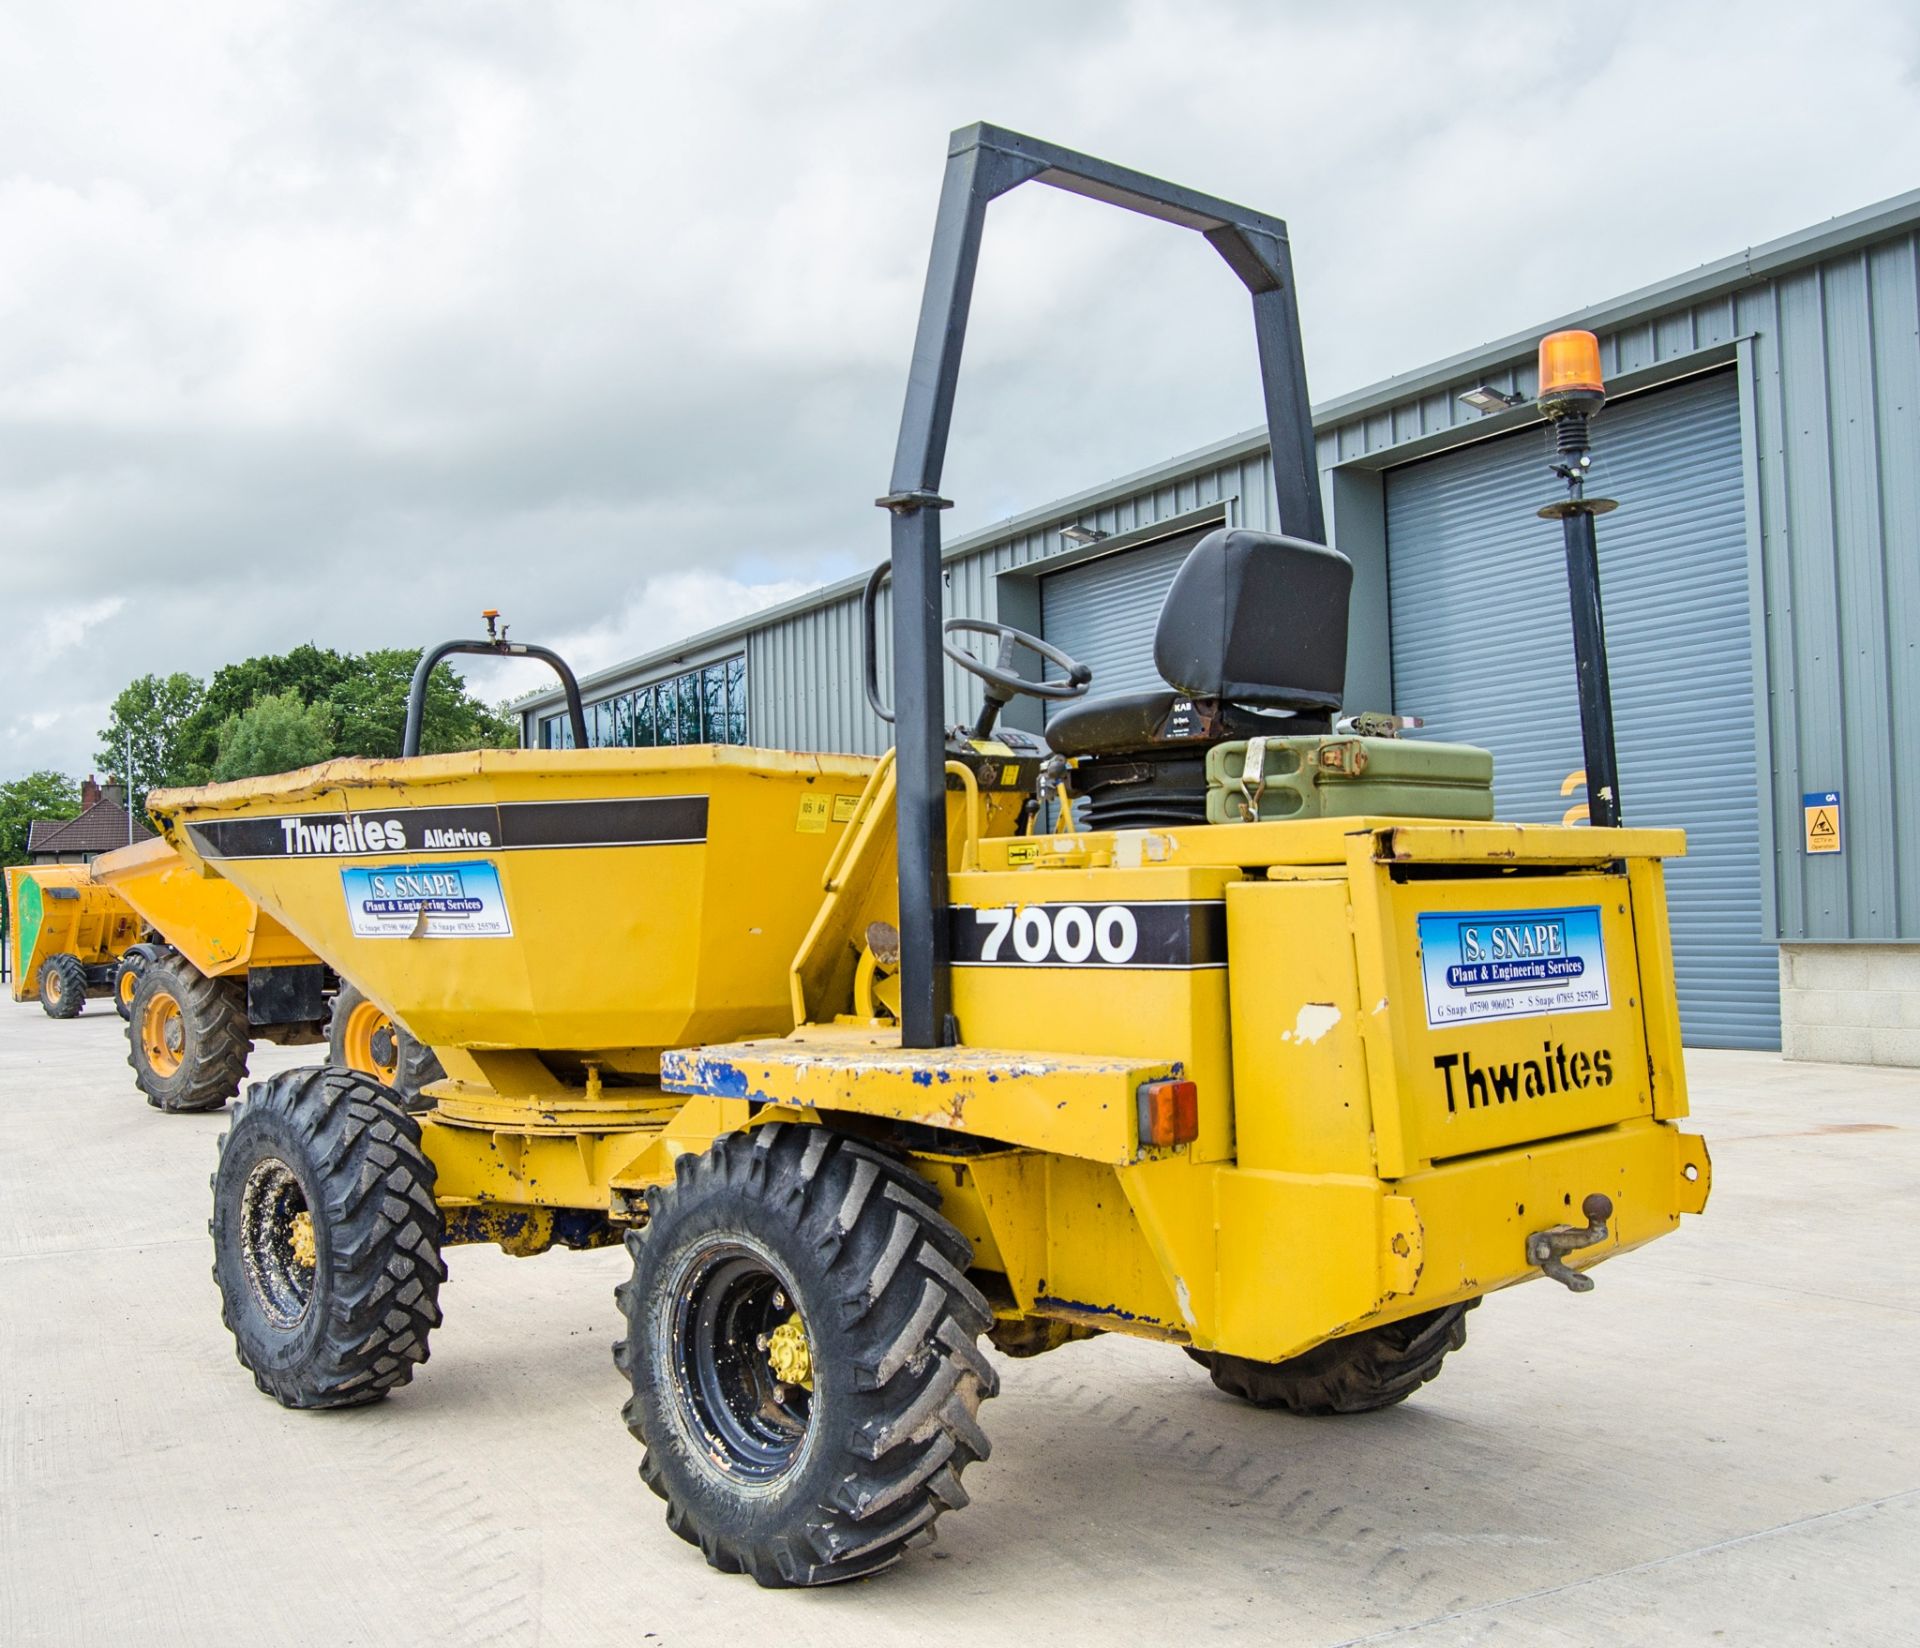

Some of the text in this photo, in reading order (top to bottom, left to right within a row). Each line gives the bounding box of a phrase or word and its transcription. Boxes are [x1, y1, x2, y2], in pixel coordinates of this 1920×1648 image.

[281, 815, 492, 853] Thwaites Alldrive
[374, 873, 459, 898] S. SNAPE
[366, 901, 386, 912] Plant
[388, 901, 395, 911] &
[447, 898, 481, 911] Services
[975, 906, 1138, 963] 7000
[1465, 924, 1562, 961] S. SNAPE
[1452, 959, 1582, 983] Plant & Engineering Services
[1437, 1005, 1444, 1017] G
[1446, 1004, 1468, 1017] Snape
[1469, 1000, 1490, 1013] 07590
[1491, 997, 1515, 1010] 906023
[1528, 995, 1534, 1007] S
[1535, 994, 1555, 1008] Snape
[1556, 991, 1575, 1004] 07855
[1576, 989, 1599, 1003] 255705
[1434, 1040, 1613, 1113] Thwaites
